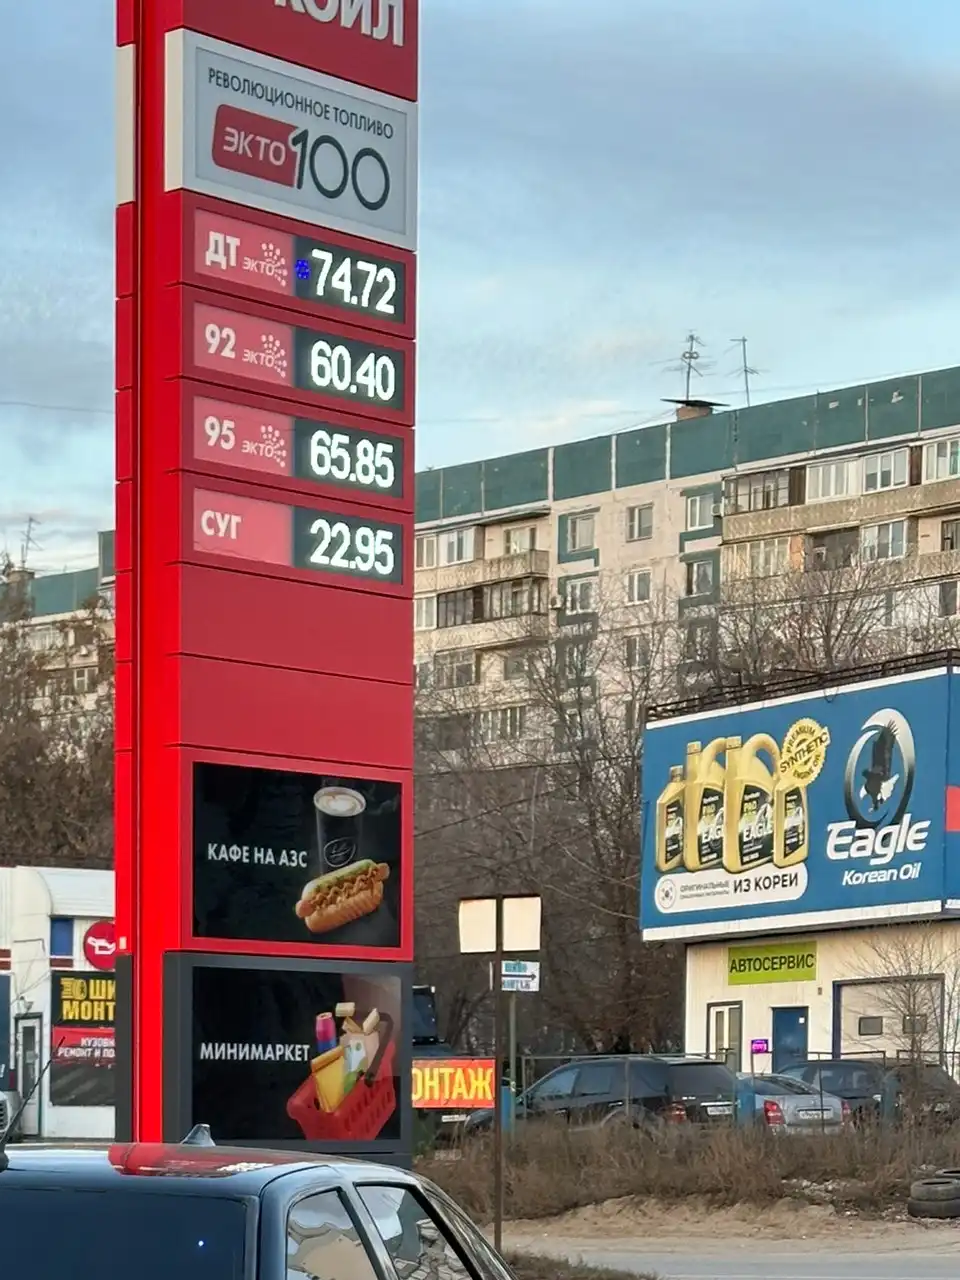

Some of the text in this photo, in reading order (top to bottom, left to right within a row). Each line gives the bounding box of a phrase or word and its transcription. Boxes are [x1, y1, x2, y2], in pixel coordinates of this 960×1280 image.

[208, 67, 394, 139] РЕВОЛЮЦИОННОЕ ТОПЛИВО
[223, 126, 390, 211] ЭКТО 100
[205, 231, 275, 276] ДТ ЭКТО
[311, 248, 396, 315] 74.72
[205, 323, 275, 368] 92 ЭКТО
[310, 340, 396, 401] 60.40
[204, 415, 274, 458] 95 ЭКТО
[310, 430, 395, 489] 65.85
[201, 510, 241, 539] СУГ
[309, 518, 395, 576] 22.95
[780, 731, 828, 773] SYNTHETIC
[208, 843, 307, 868] КАФЕ НА АЗС
[826, 813, 931, 865] Eagle
[733, 872, 799, 894] ИЗ КОРЕИ
[842, 861, 922, 886] Korean Oil
[730, 953, 814, 973] АВТОСЕРВИС
[62, 1000, 116, 1021] МОНТ
[199, 1042, 310, 1062] МИНИМАРКЕТ
